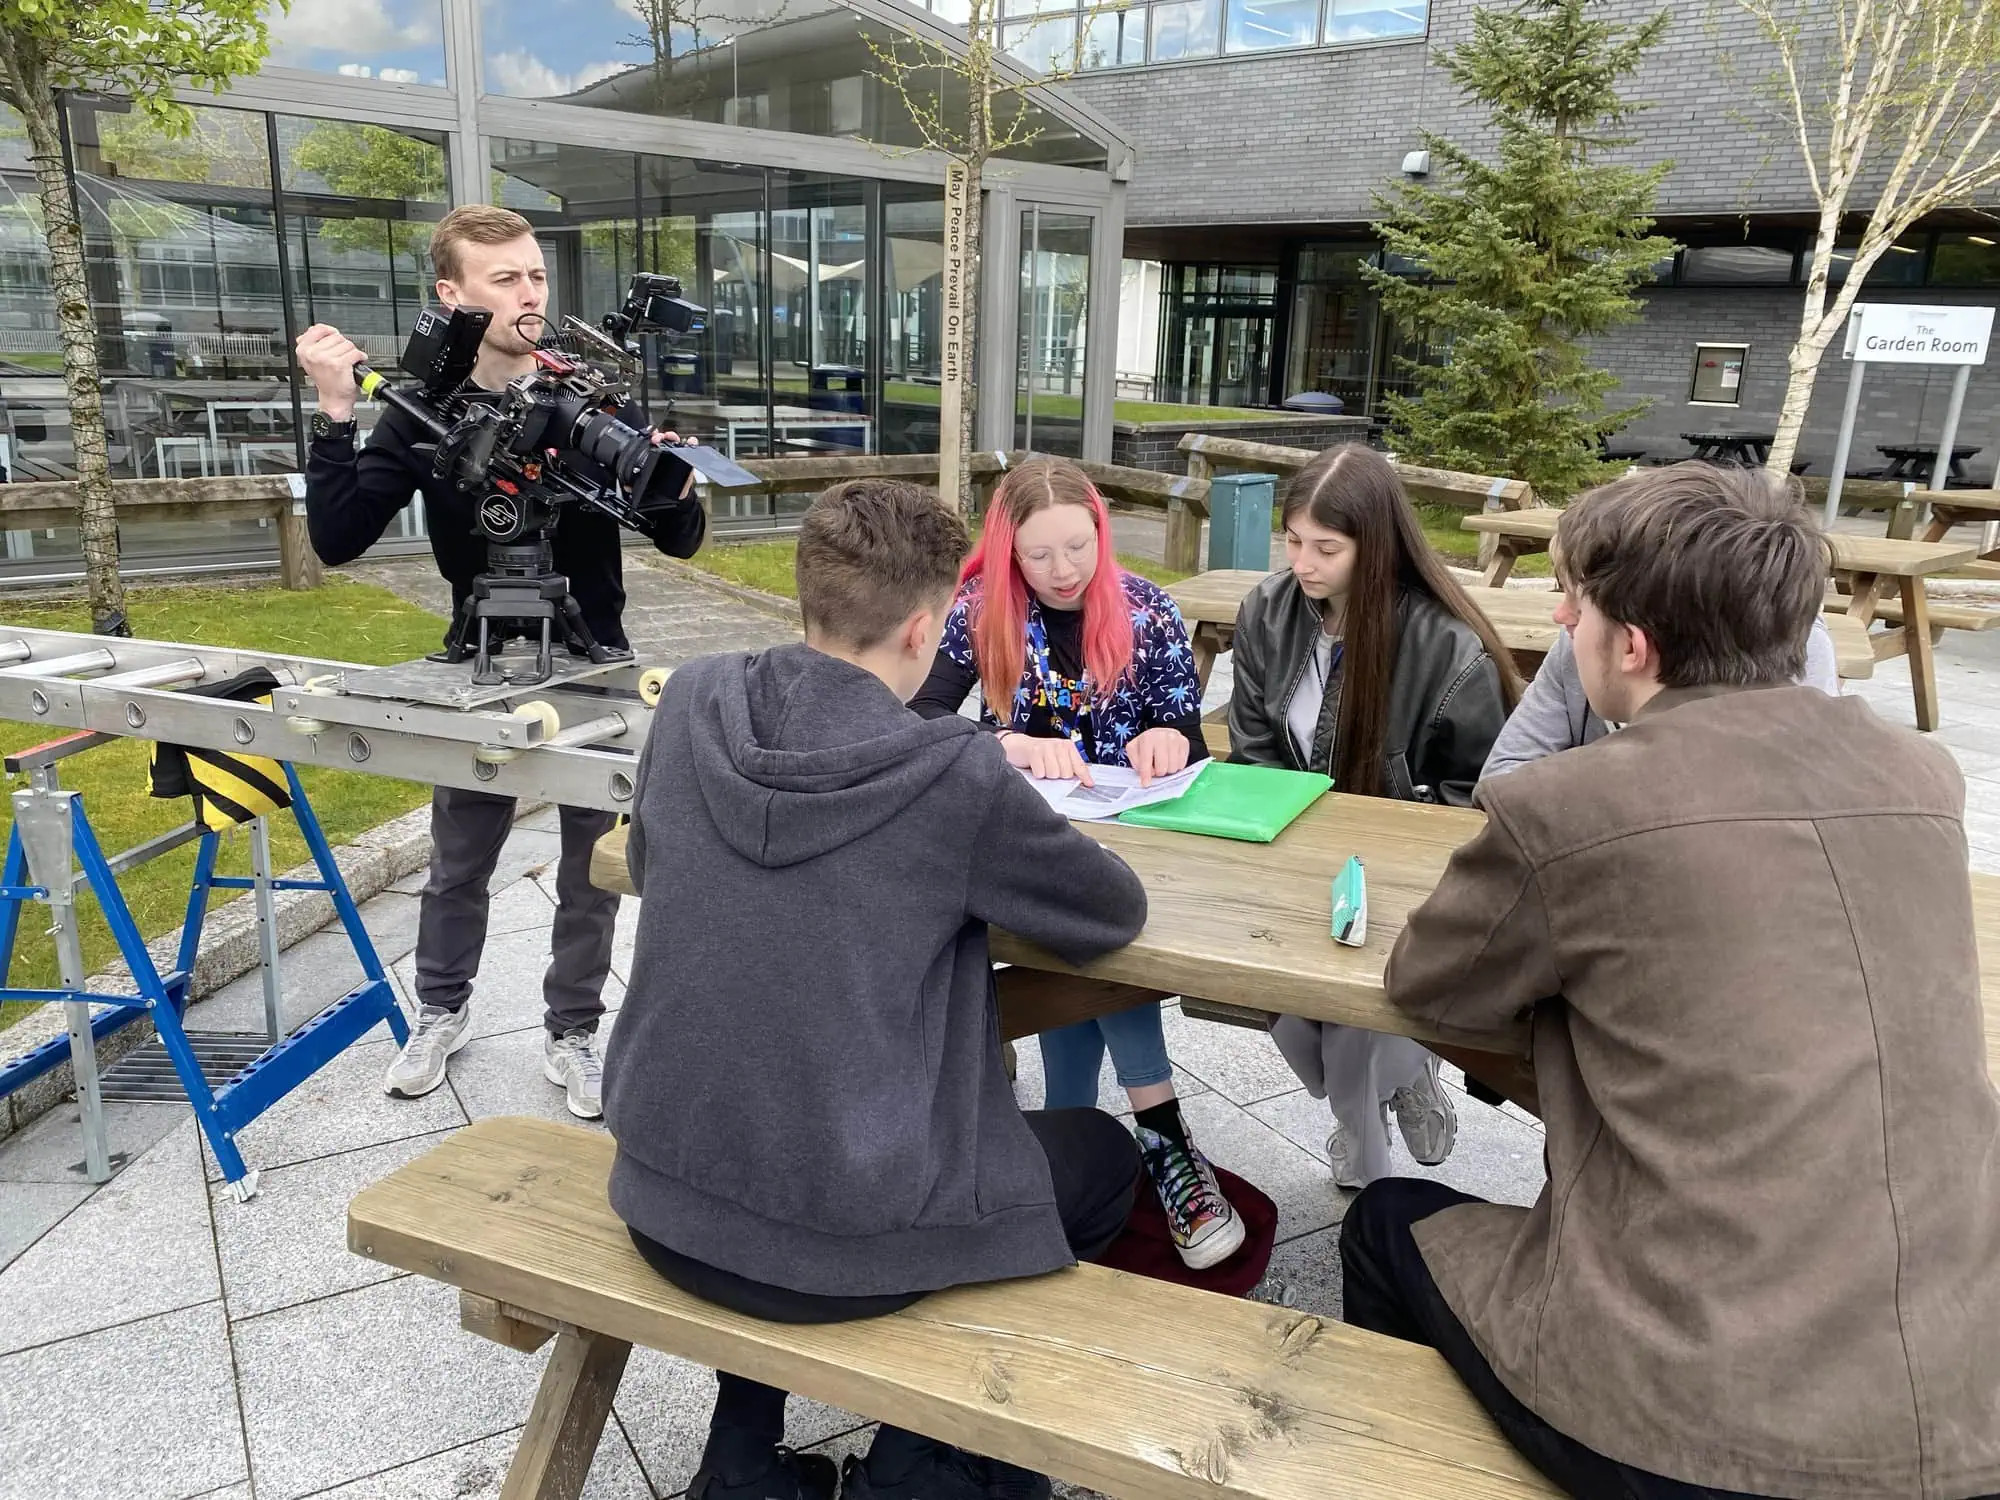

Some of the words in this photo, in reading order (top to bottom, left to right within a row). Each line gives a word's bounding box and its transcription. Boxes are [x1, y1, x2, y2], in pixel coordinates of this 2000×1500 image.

[949, 170, 963, 200] May
[950, 207, 962, 252] Peace
[949, 259, 961, 310] Prevail
[948, 316, 960, 336] On
[1916, 325, 1935, 335] The
[1866, 335, 1926, 351] Garden
[1931, 337, 1978, 353] Room
[947, 344, 959, 382] Earth
